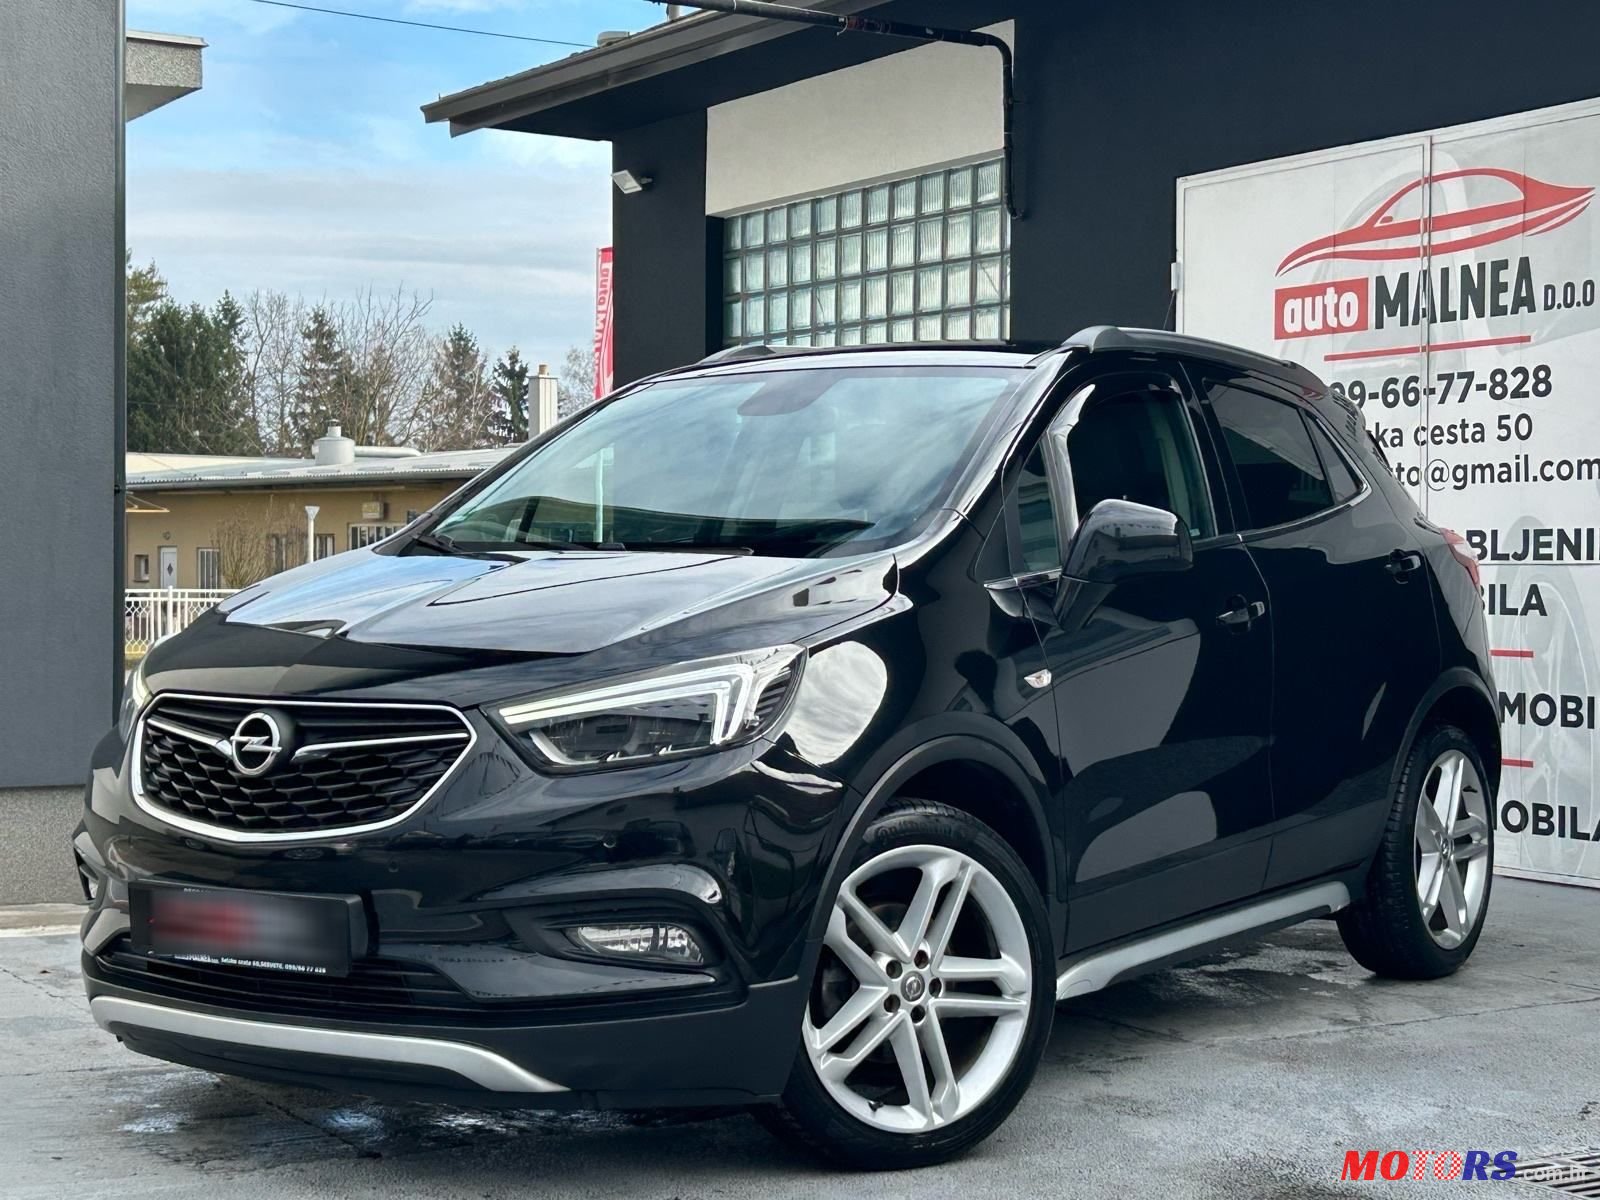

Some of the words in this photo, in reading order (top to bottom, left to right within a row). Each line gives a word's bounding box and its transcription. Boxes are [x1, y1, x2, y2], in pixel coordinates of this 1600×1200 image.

[1283, 286, 1359, 333] auto
[1374, 256, 1536, 330] MALNEA
[1543, 280, 1595, 311] D.O.O
[1413, 418, 1485, 446] cesta
[1496, 413, 1533, 441] 50
[1388, 454, 1600, 491] to@gmail.com
[1466, 528, 1600, 561] BLJENI
[1480, 583, 1548, 616] ILA
[1493, 800, 1600, 842] OBIL
